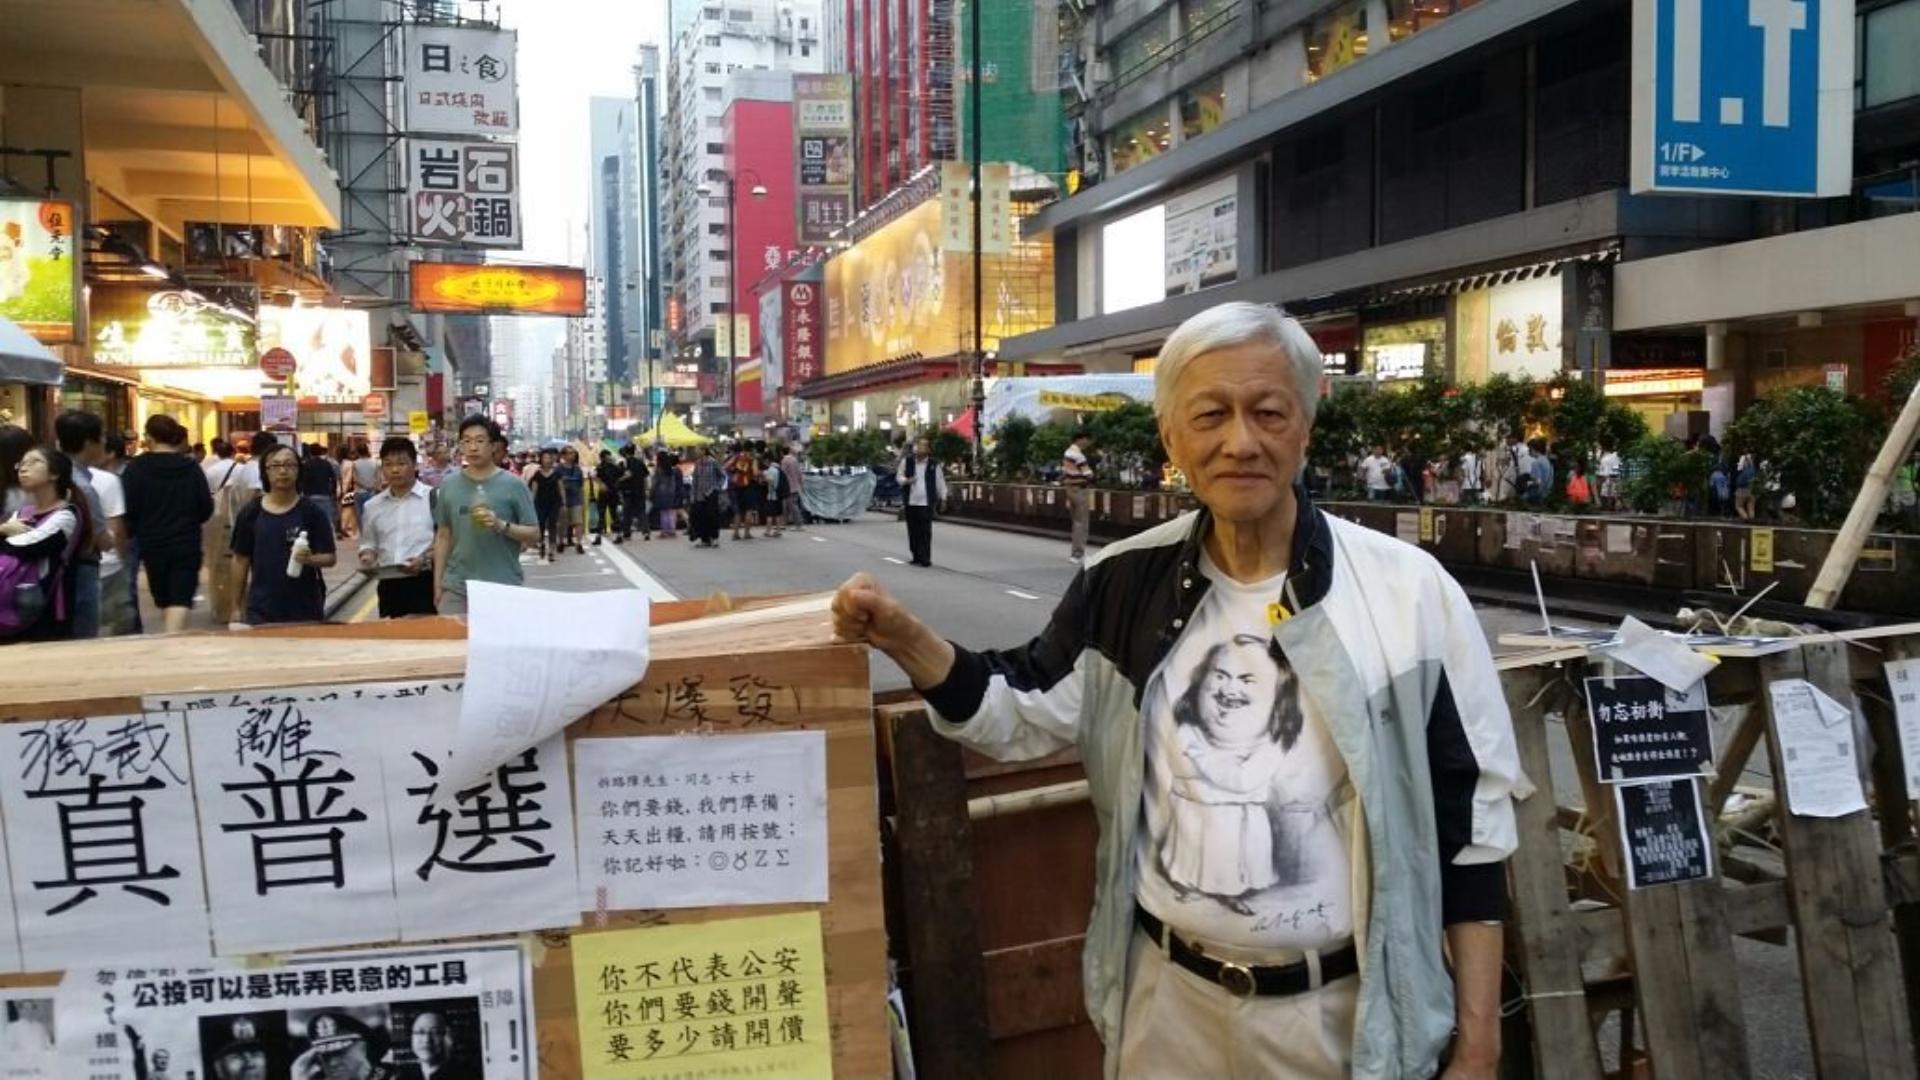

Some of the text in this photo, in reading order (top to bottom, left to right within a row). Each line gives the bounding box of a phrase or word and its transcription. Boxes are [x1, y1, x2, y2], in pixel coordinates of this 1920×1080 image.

[420, 148, 509, 192] 岩石
[1661, 143, 1691, 162] 1/F
[418, 194, 512, 238] 火鍋
[807, 201, 844, 223] 周生生
[797, 308, 814, 378] 永隆銀行
[25, 746, 556, 916] 真普選
[133, 959, 469, 1009] 公投可以是玩弄民意的工具
[599, 947, 801, 992] 你不代表公安
[602, 979, 804, 1026] 你們要錢開聲
[606, 1014, 805, 1061] 要多少請開價
